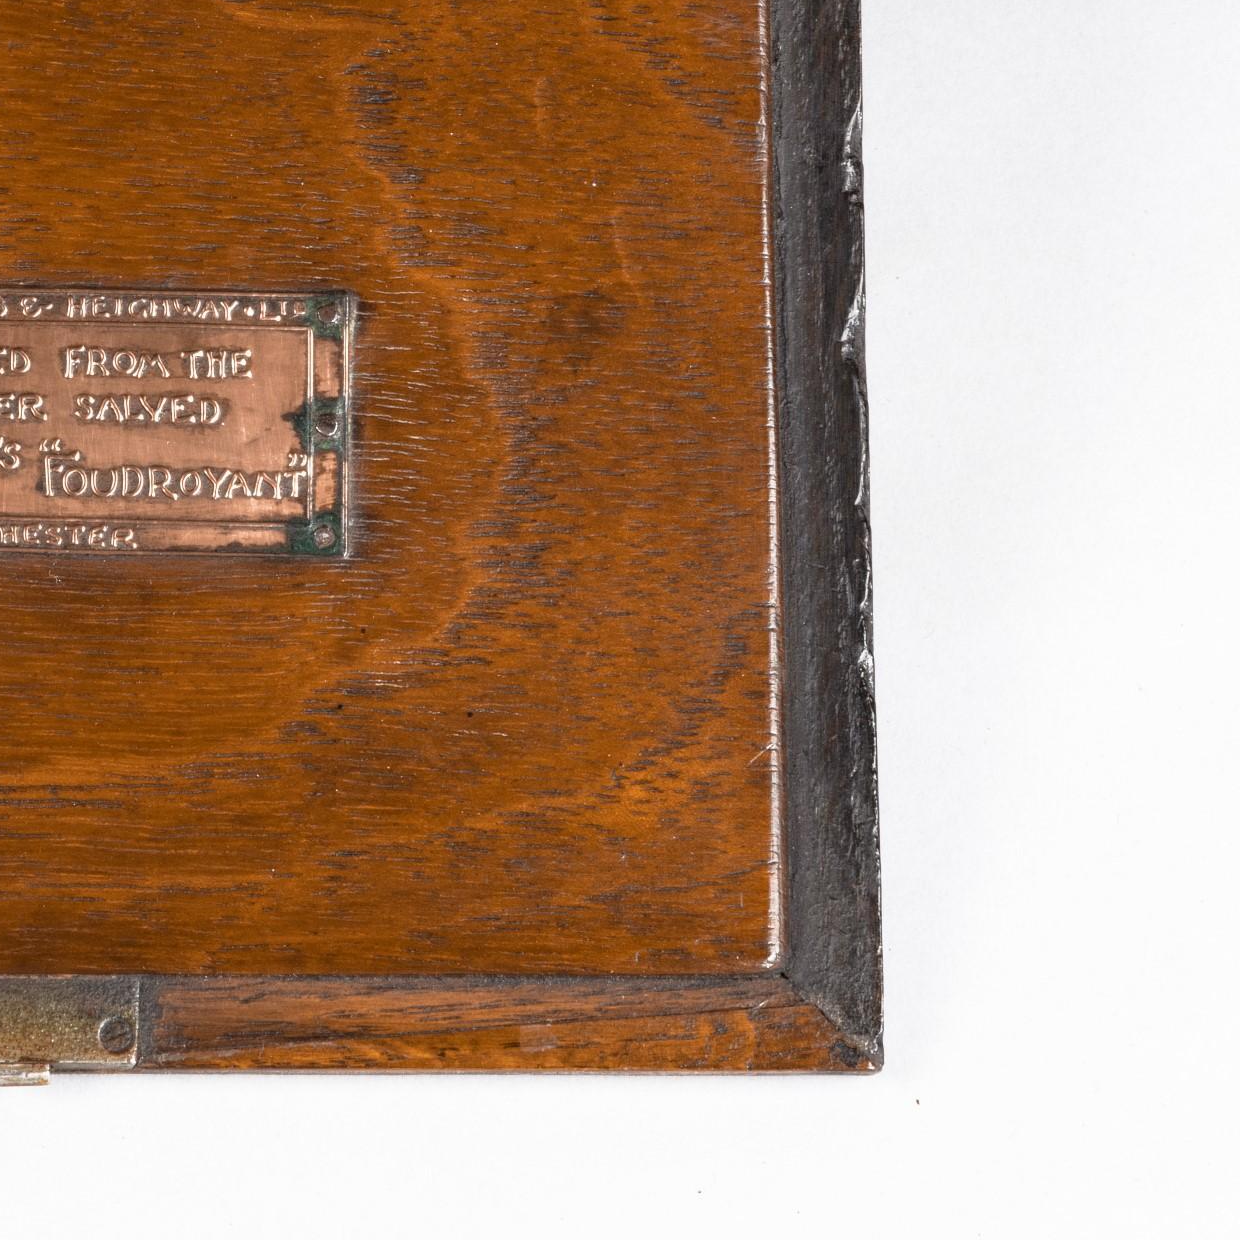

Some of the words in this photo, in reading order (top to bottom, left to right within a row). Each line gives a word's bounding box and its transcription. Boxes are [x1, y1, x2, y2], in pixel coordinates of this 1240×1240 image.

[19, 296, 54, 318] &
[66, 295, 239, 322] HEIGHWAY
[63, 345, 171, 379] FROM
[180, 349, 253, 379] THE
[74, 392, 222, 425] SALVED
